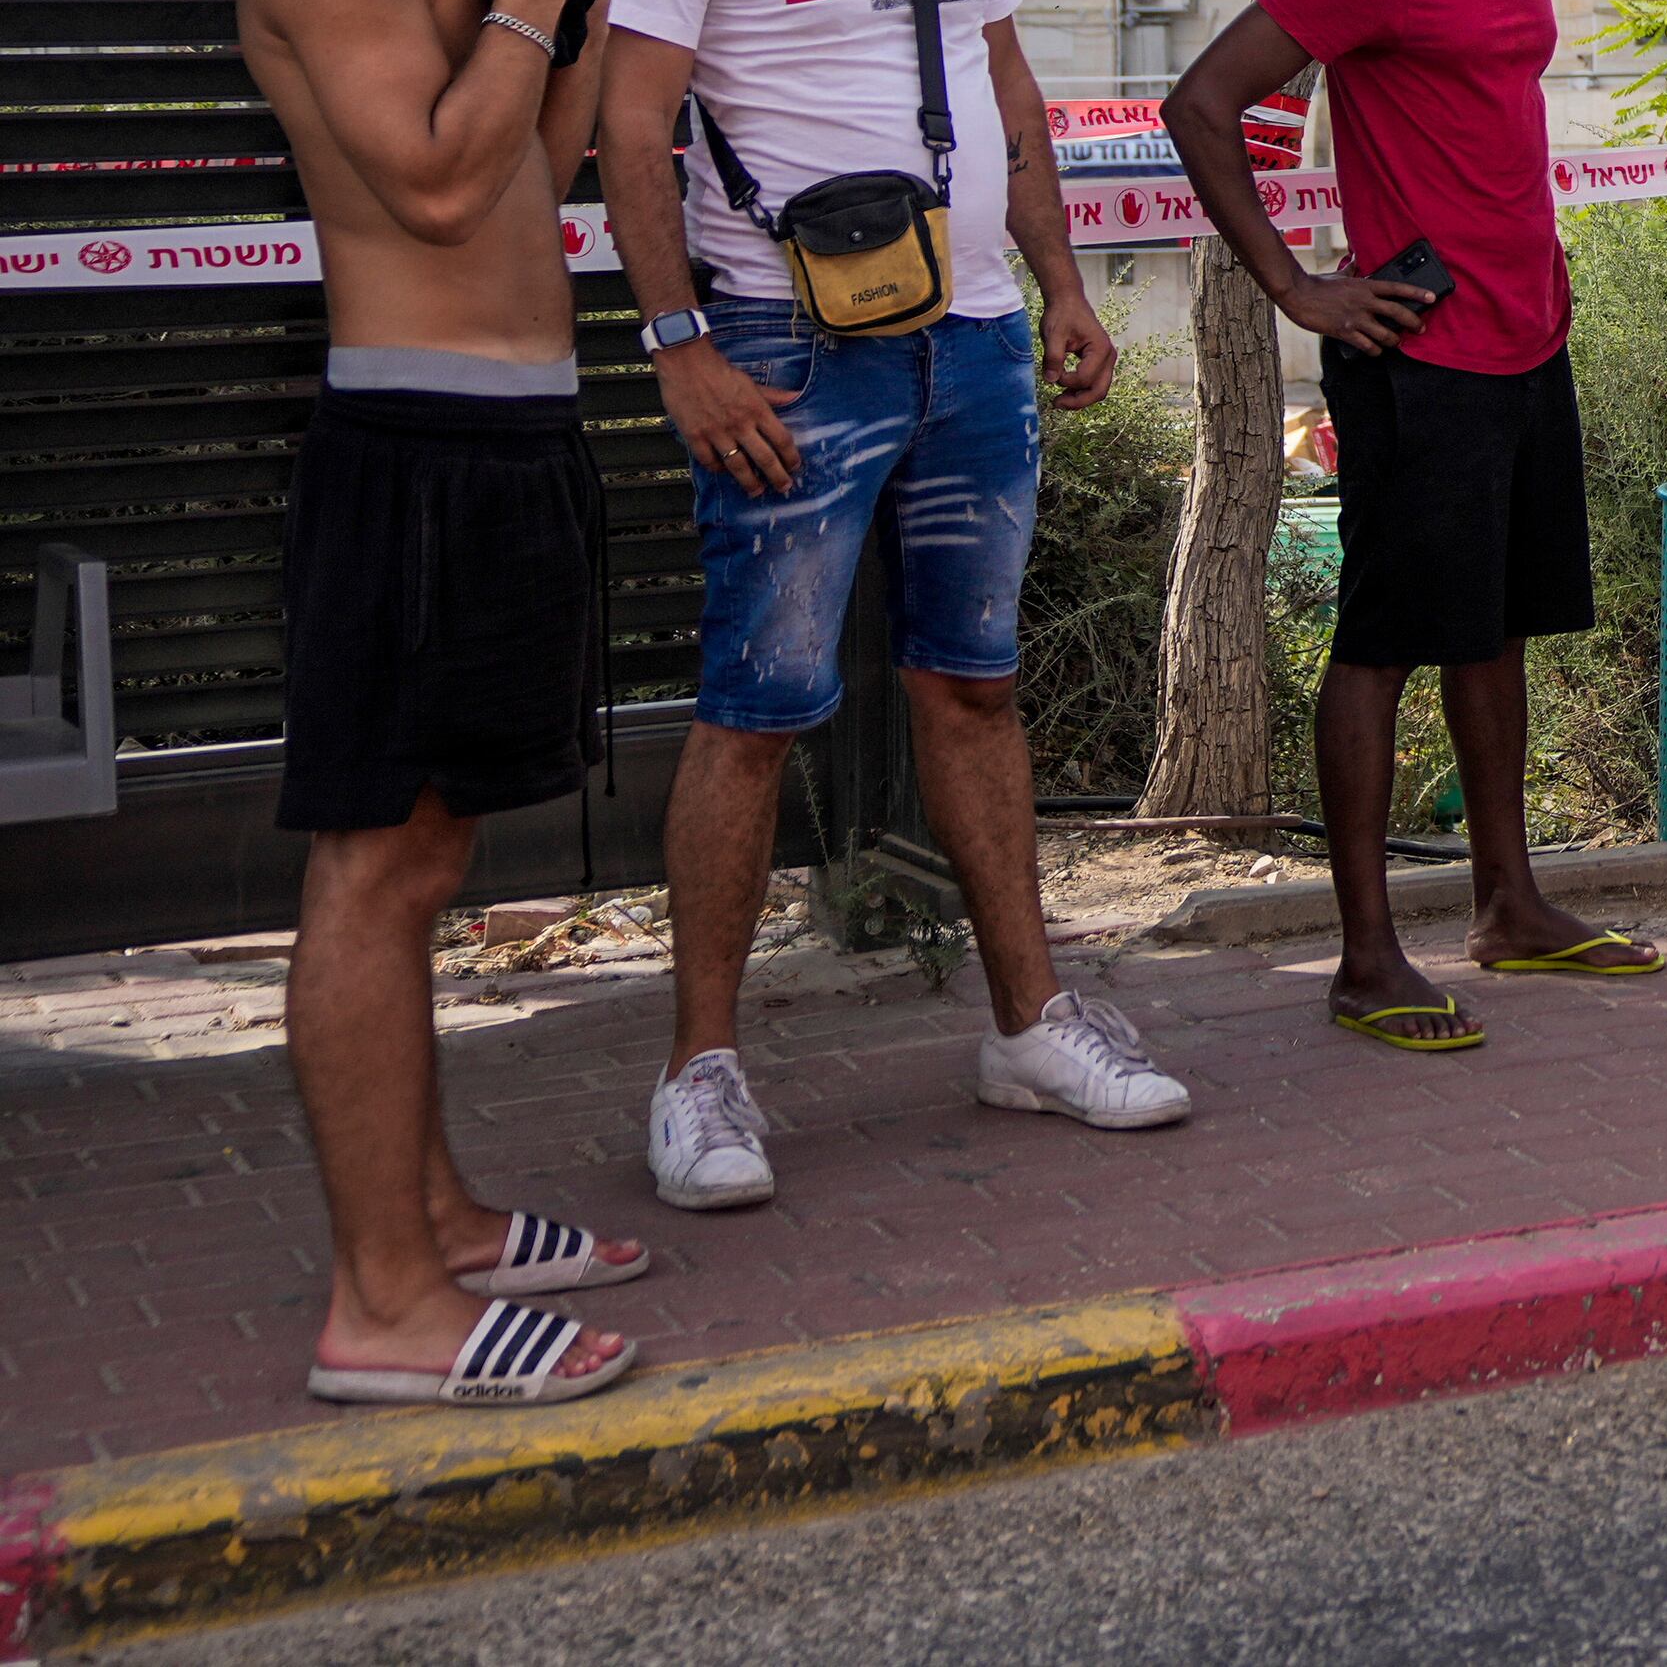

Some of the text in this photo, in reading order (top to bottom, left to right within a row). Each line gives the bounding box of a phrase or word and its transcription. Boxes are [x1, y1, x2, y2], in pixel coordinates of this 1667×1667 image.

[1582, 162, 1655, 188] ישראל
[147, 242, 302, 270] משטרת
[850, 282, 898, 307] FASHION
